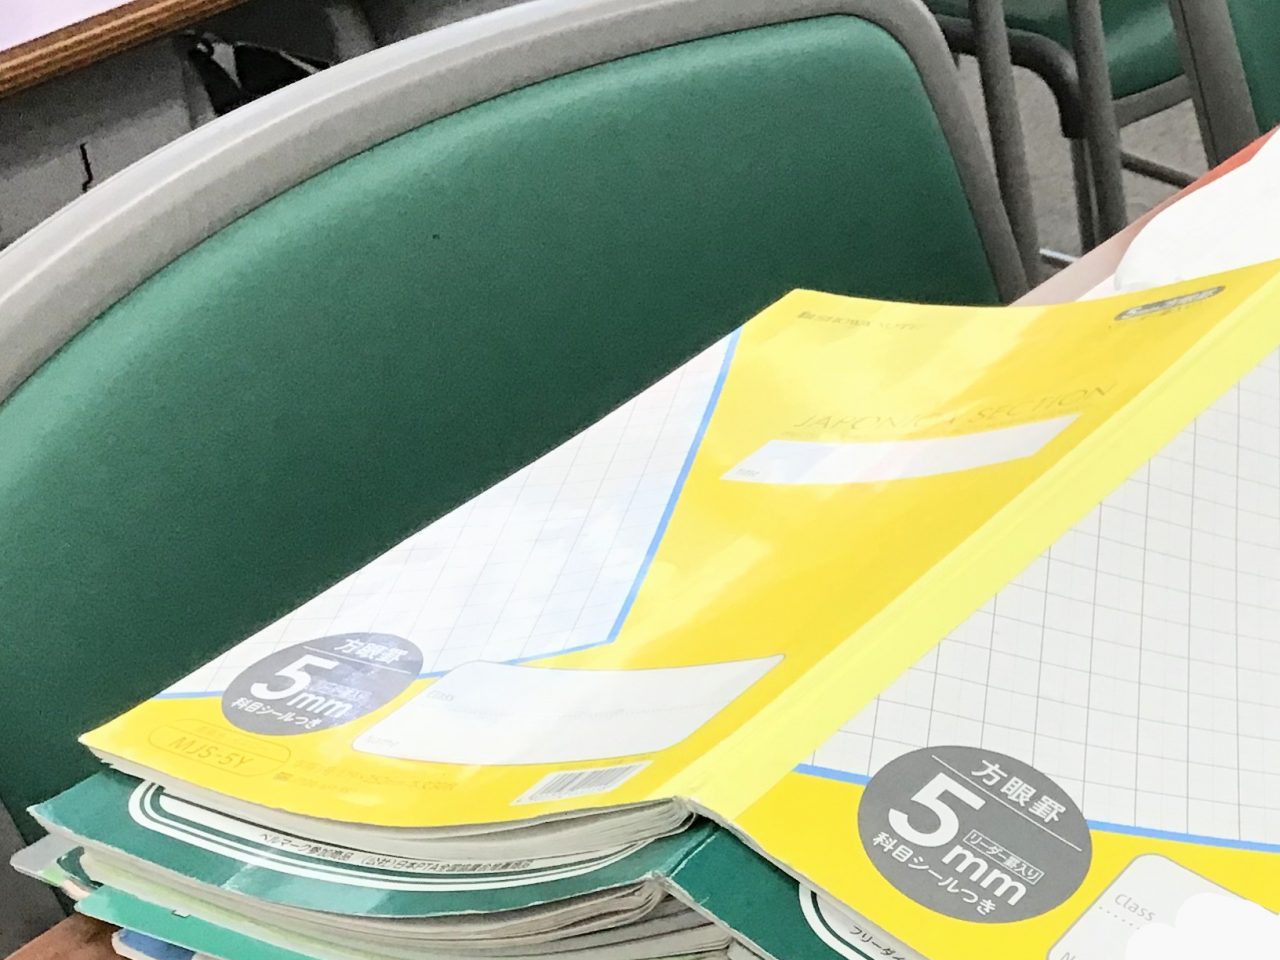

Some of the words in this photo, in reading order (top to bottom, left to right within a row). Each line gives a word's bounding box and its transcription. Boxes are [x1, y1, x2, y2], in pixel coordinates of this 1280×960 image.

[230, 696, 323, 730] 科目シールつき
[249, 653, 354, 719] 5mm
[168, 735, 257, 770] MJS-5Y
[970, 758, 1067, 825] 方眼罫
[886, 772, 1028, 907] 5mm
[967, 830, 1041, 884] リーダー罫入り
[872, 829, 997, 917] 科目シールつき
[1113, 892, 1157, 923] Class
